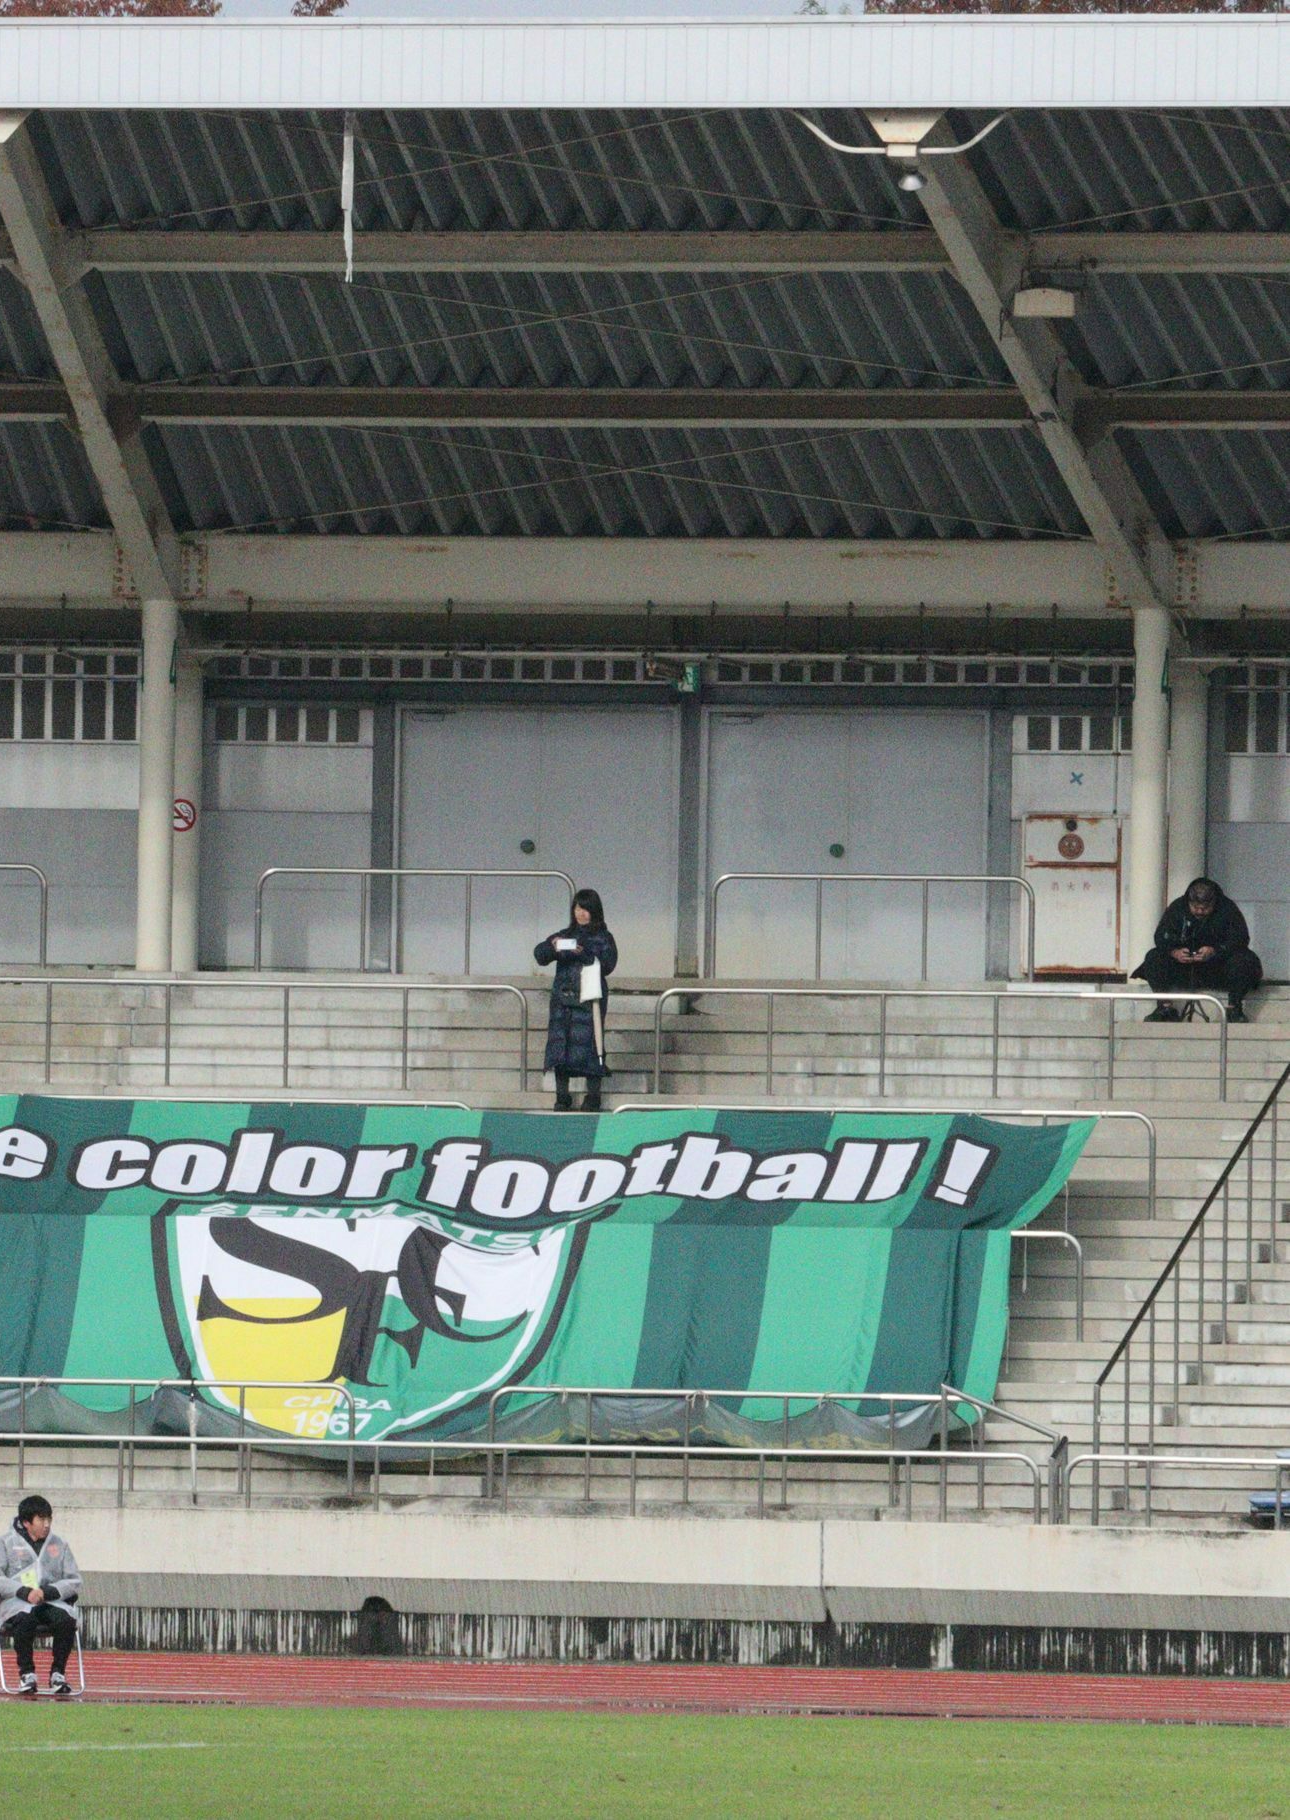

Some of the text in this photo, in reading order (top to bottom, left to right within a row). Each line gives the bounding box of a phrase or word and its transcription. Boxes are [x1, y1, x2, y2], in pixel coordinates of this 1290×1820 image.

[70, 1127, 416, 1201] color
[421, 1131, 929, 1221] football
[284, 1391, 392, 1411] CHIBA
[293, 1410, 372, 1435] 1967
